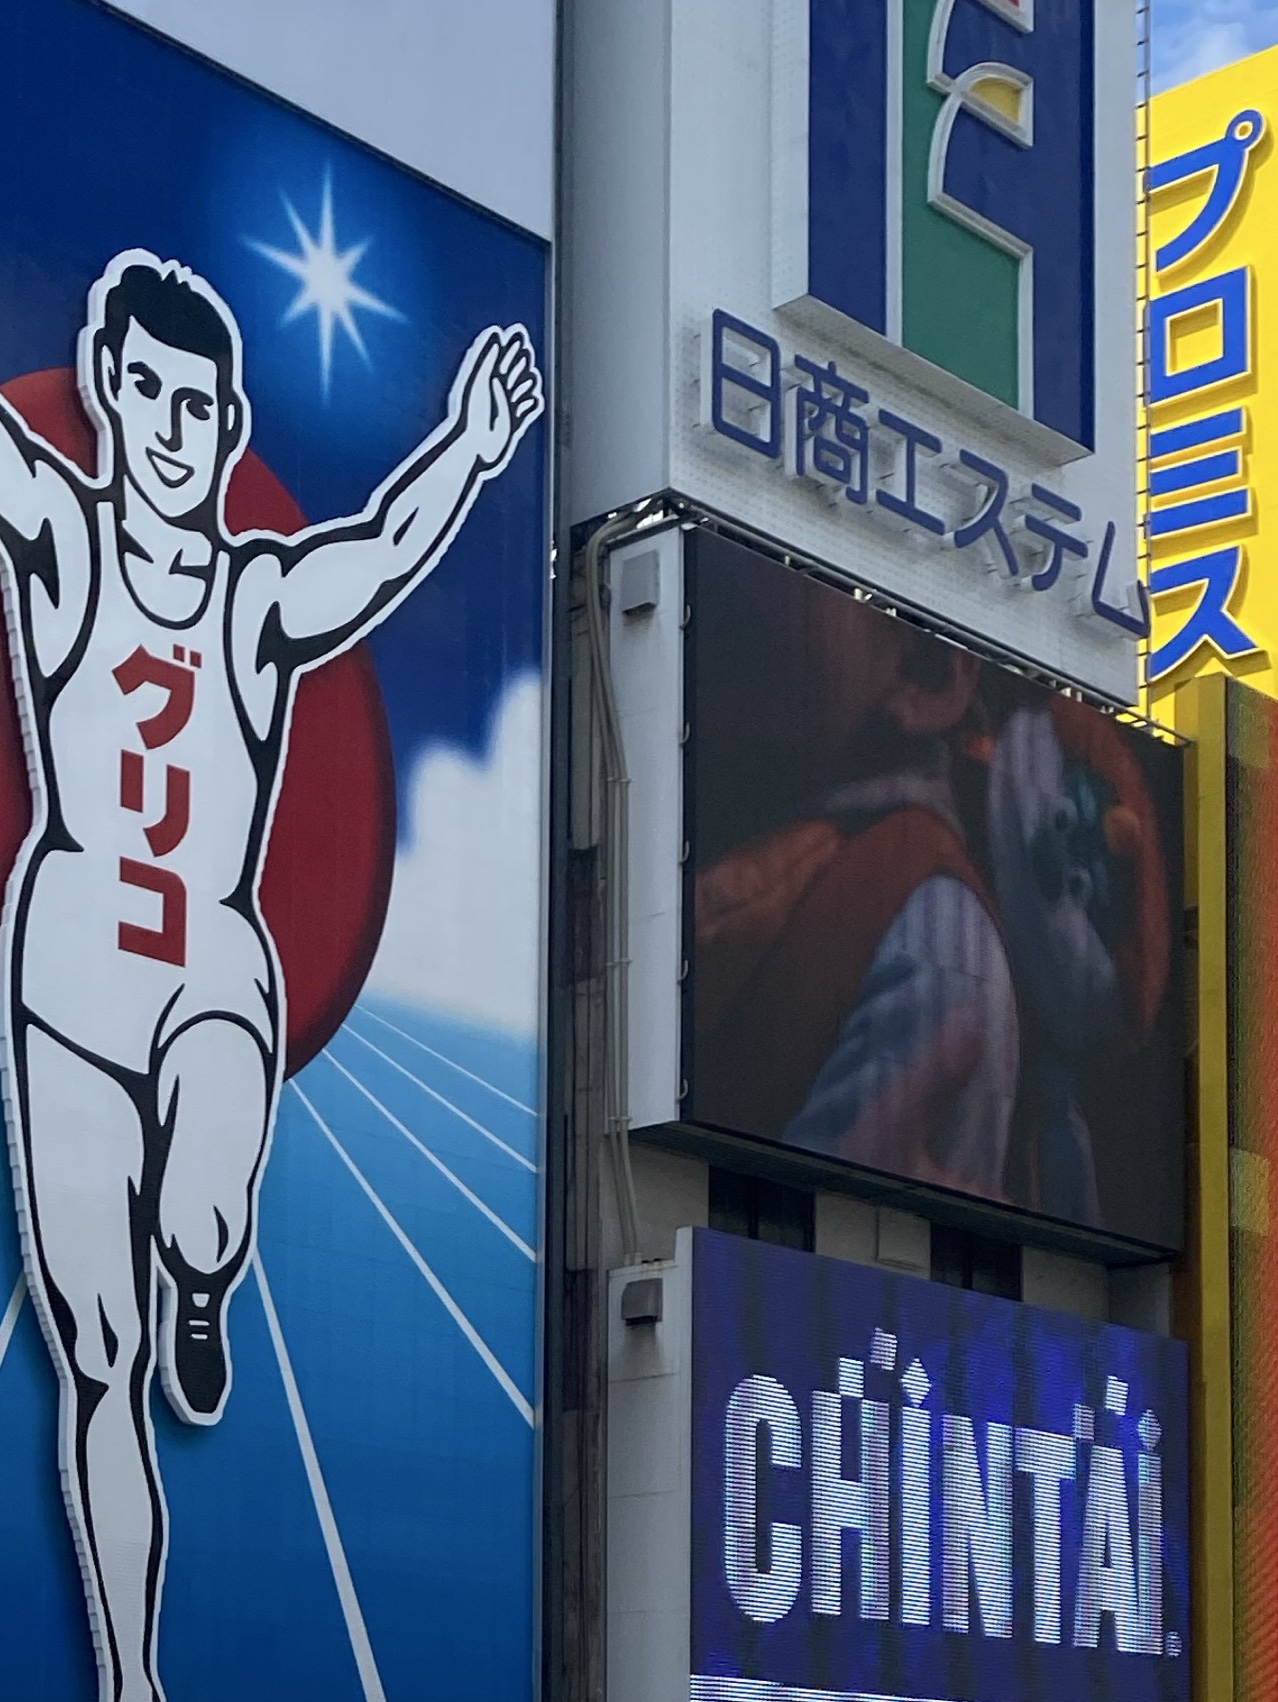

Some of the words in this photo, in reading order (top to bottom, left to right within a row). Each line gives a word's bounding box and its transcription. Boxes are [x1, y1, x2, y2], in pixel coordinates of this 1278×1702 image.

[712, 308, 1152, 639] 日商エステム
[1146, 108, 1265, 682] プロミス
[111, 643, 202, 968] グリコ
